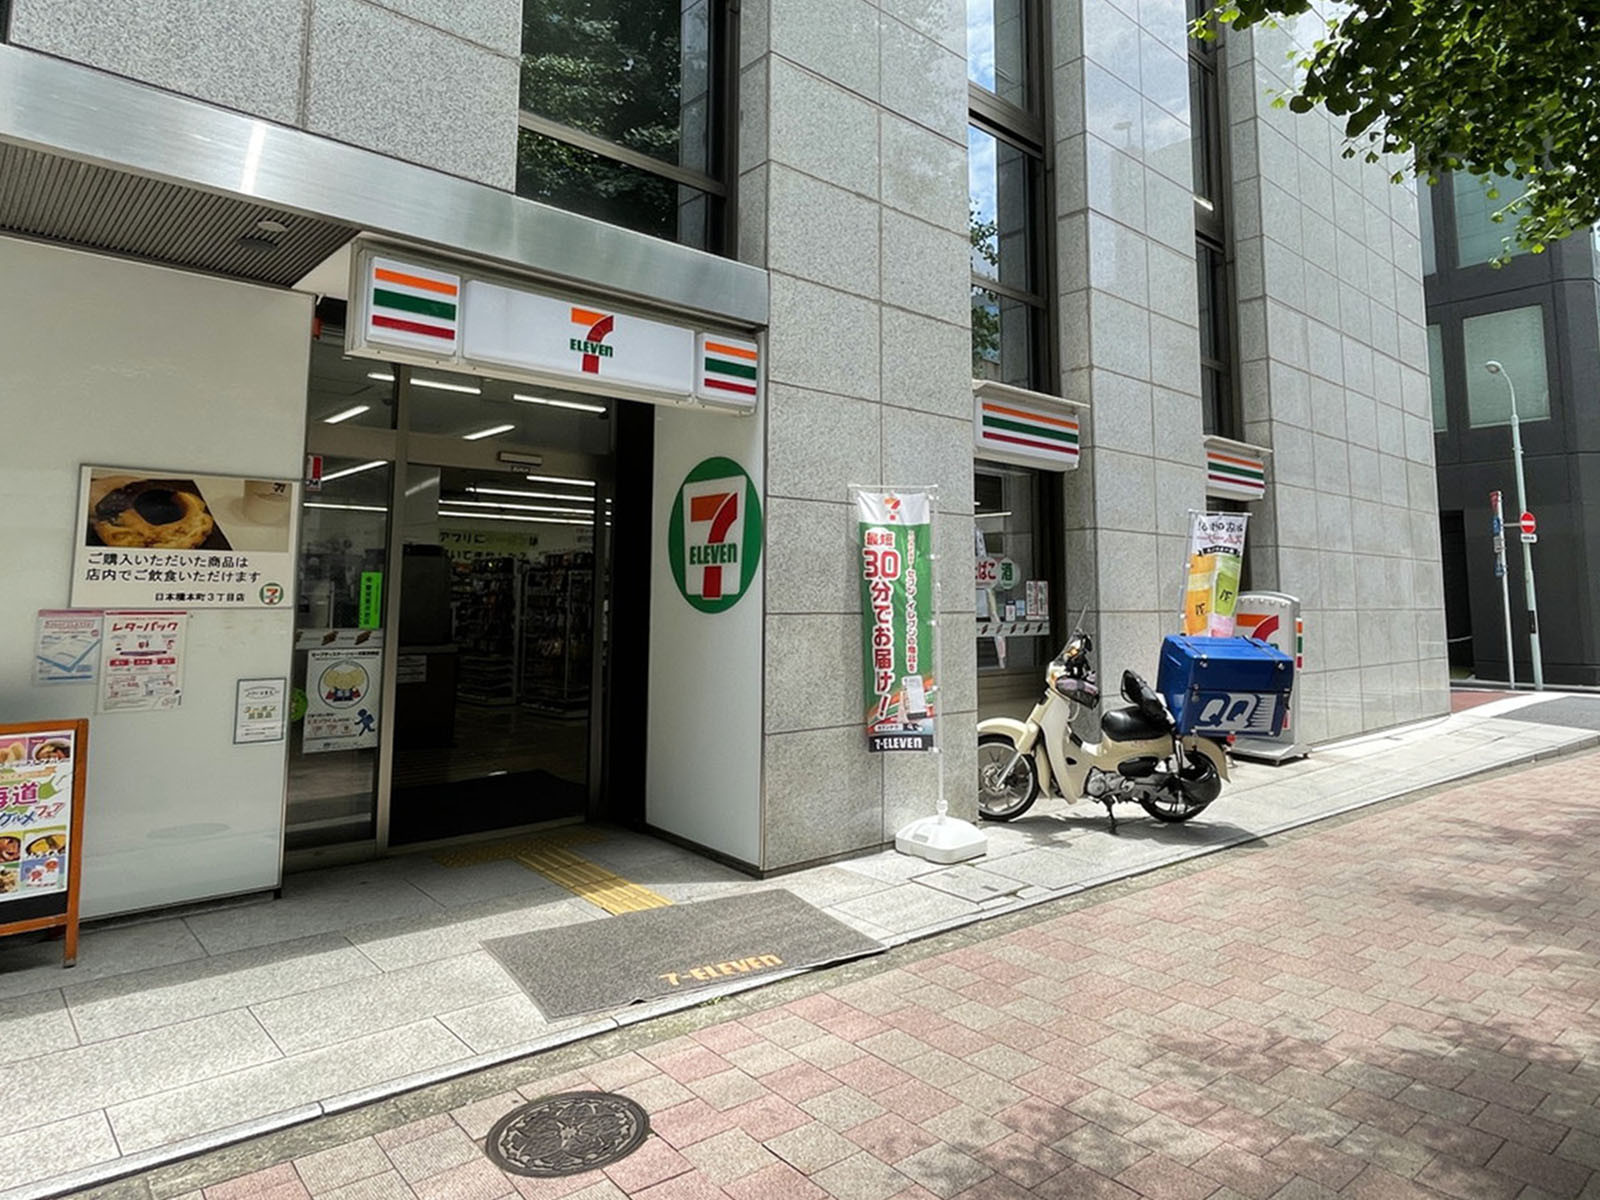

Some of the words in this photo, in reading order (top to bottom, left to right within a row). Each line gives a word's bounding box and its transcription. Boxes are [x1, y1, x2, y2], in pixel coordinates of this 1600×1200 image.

[88, 552, 249, 569] ご購入いただいた商品は
[85, 568, 261, 583] 店内でご飲食いただけます
[975, 561, 997, 581] ばこ
[1000, 562, 1013, 582] 酒
